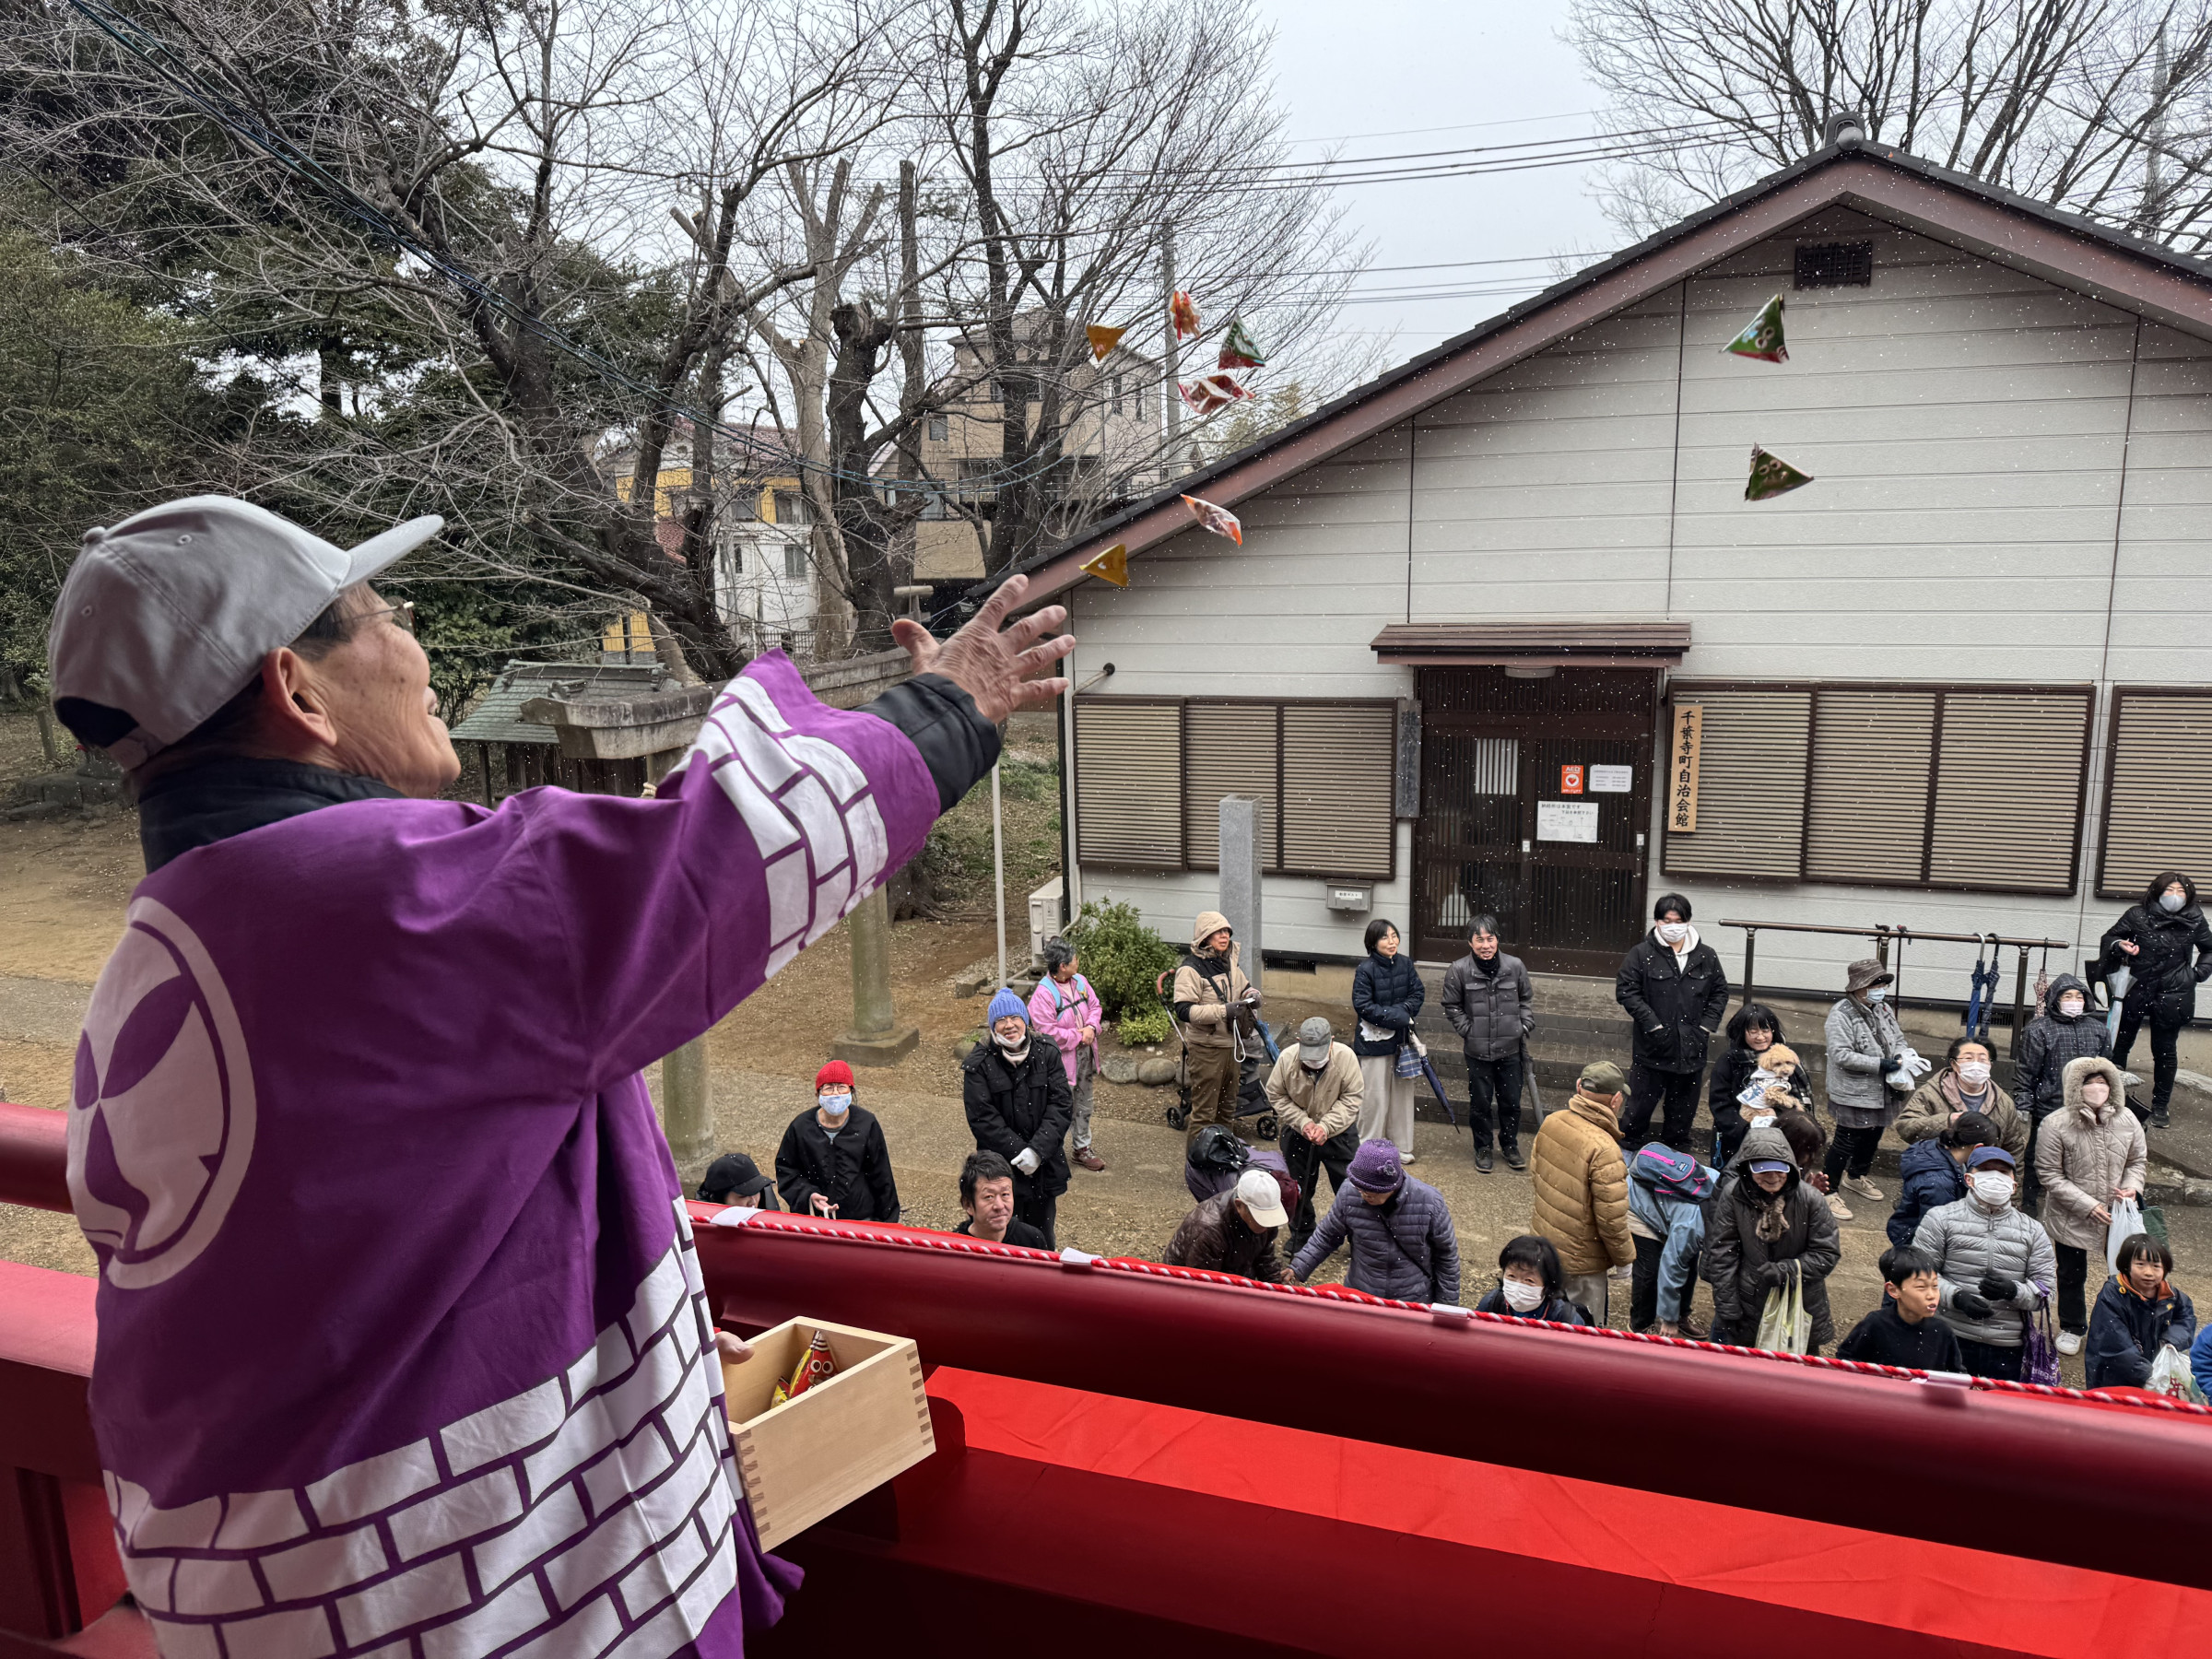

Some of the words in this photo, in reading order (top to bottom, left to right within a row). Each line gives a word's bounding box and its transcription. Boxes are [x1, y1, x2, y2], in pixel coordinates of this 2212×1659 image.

[1675, 711, 1695, 827] 千葉寺町自治会館
